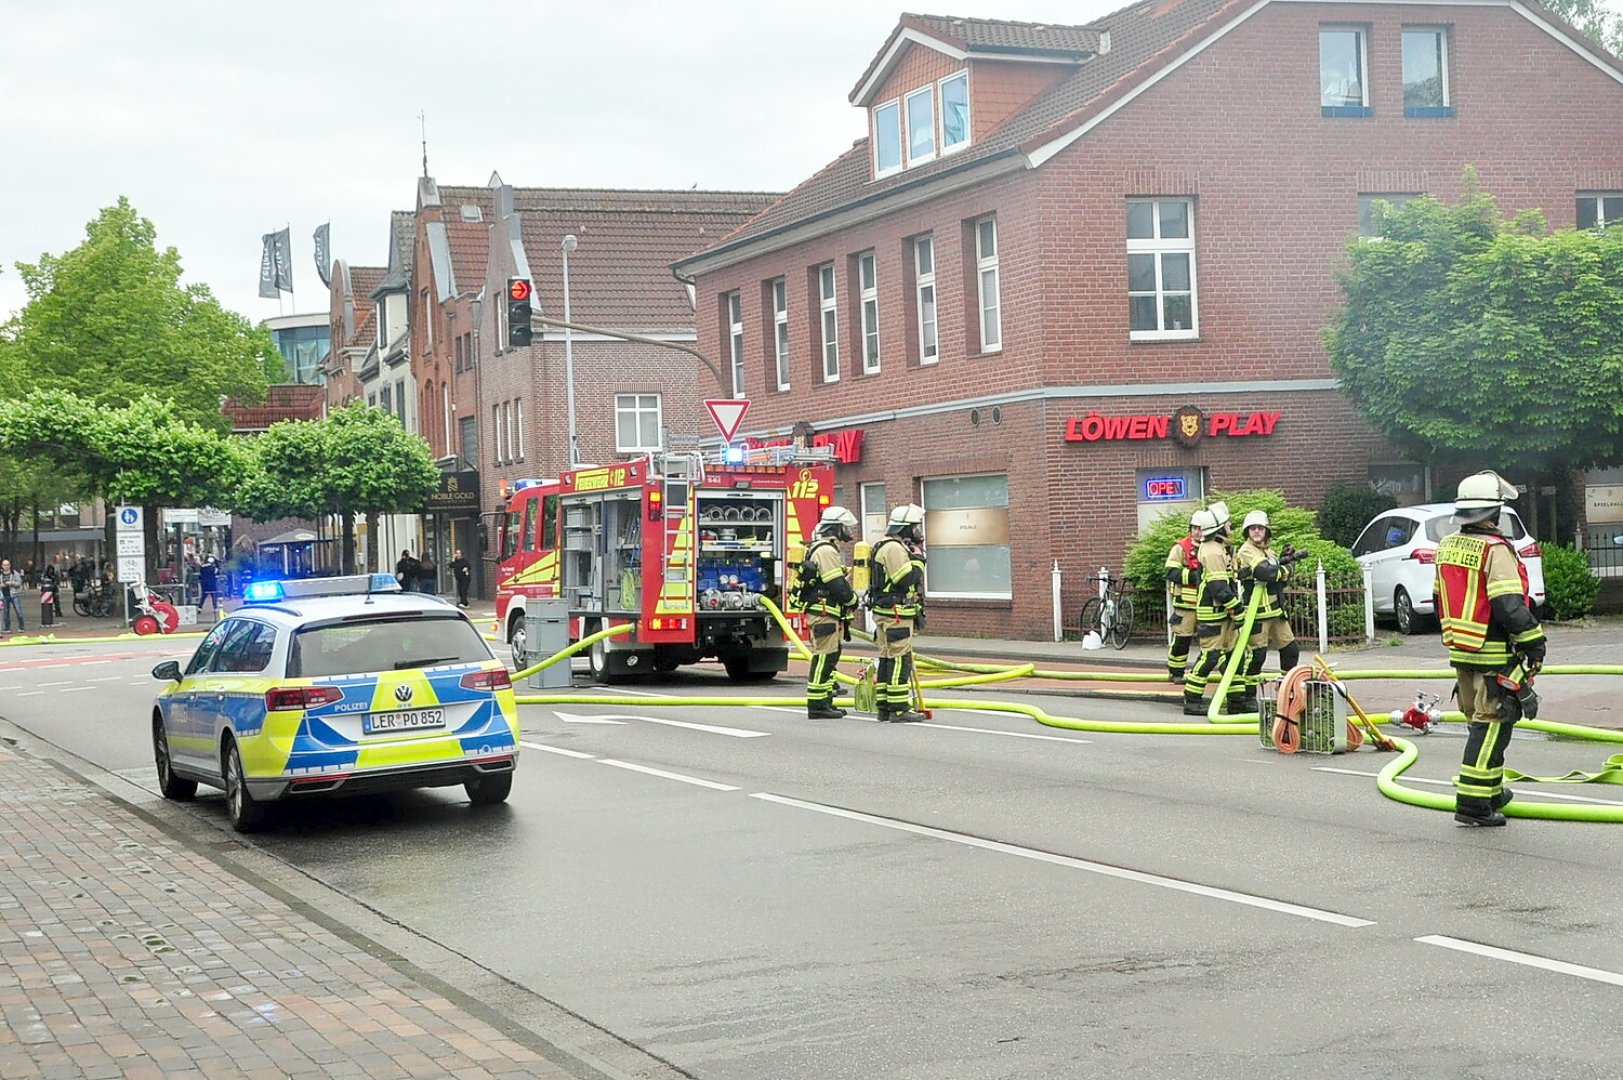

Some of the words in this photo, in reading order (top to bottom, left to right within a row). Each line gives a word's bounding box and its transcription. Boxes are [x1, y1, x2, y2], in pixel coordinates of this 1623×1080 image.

[1065, 412, 1169, 441] LÖWEN
[1208, 412, 1282, 436] PLAY
[791, 480, 819, 498] 112
[1461, 552, 1479, 567] LEER
[334, 702, 368, 712] POLIZEI
[371, 714, 396, 729] LER
[402, 712, 418, 727] PO
[421, 710, 442, 725] 852
